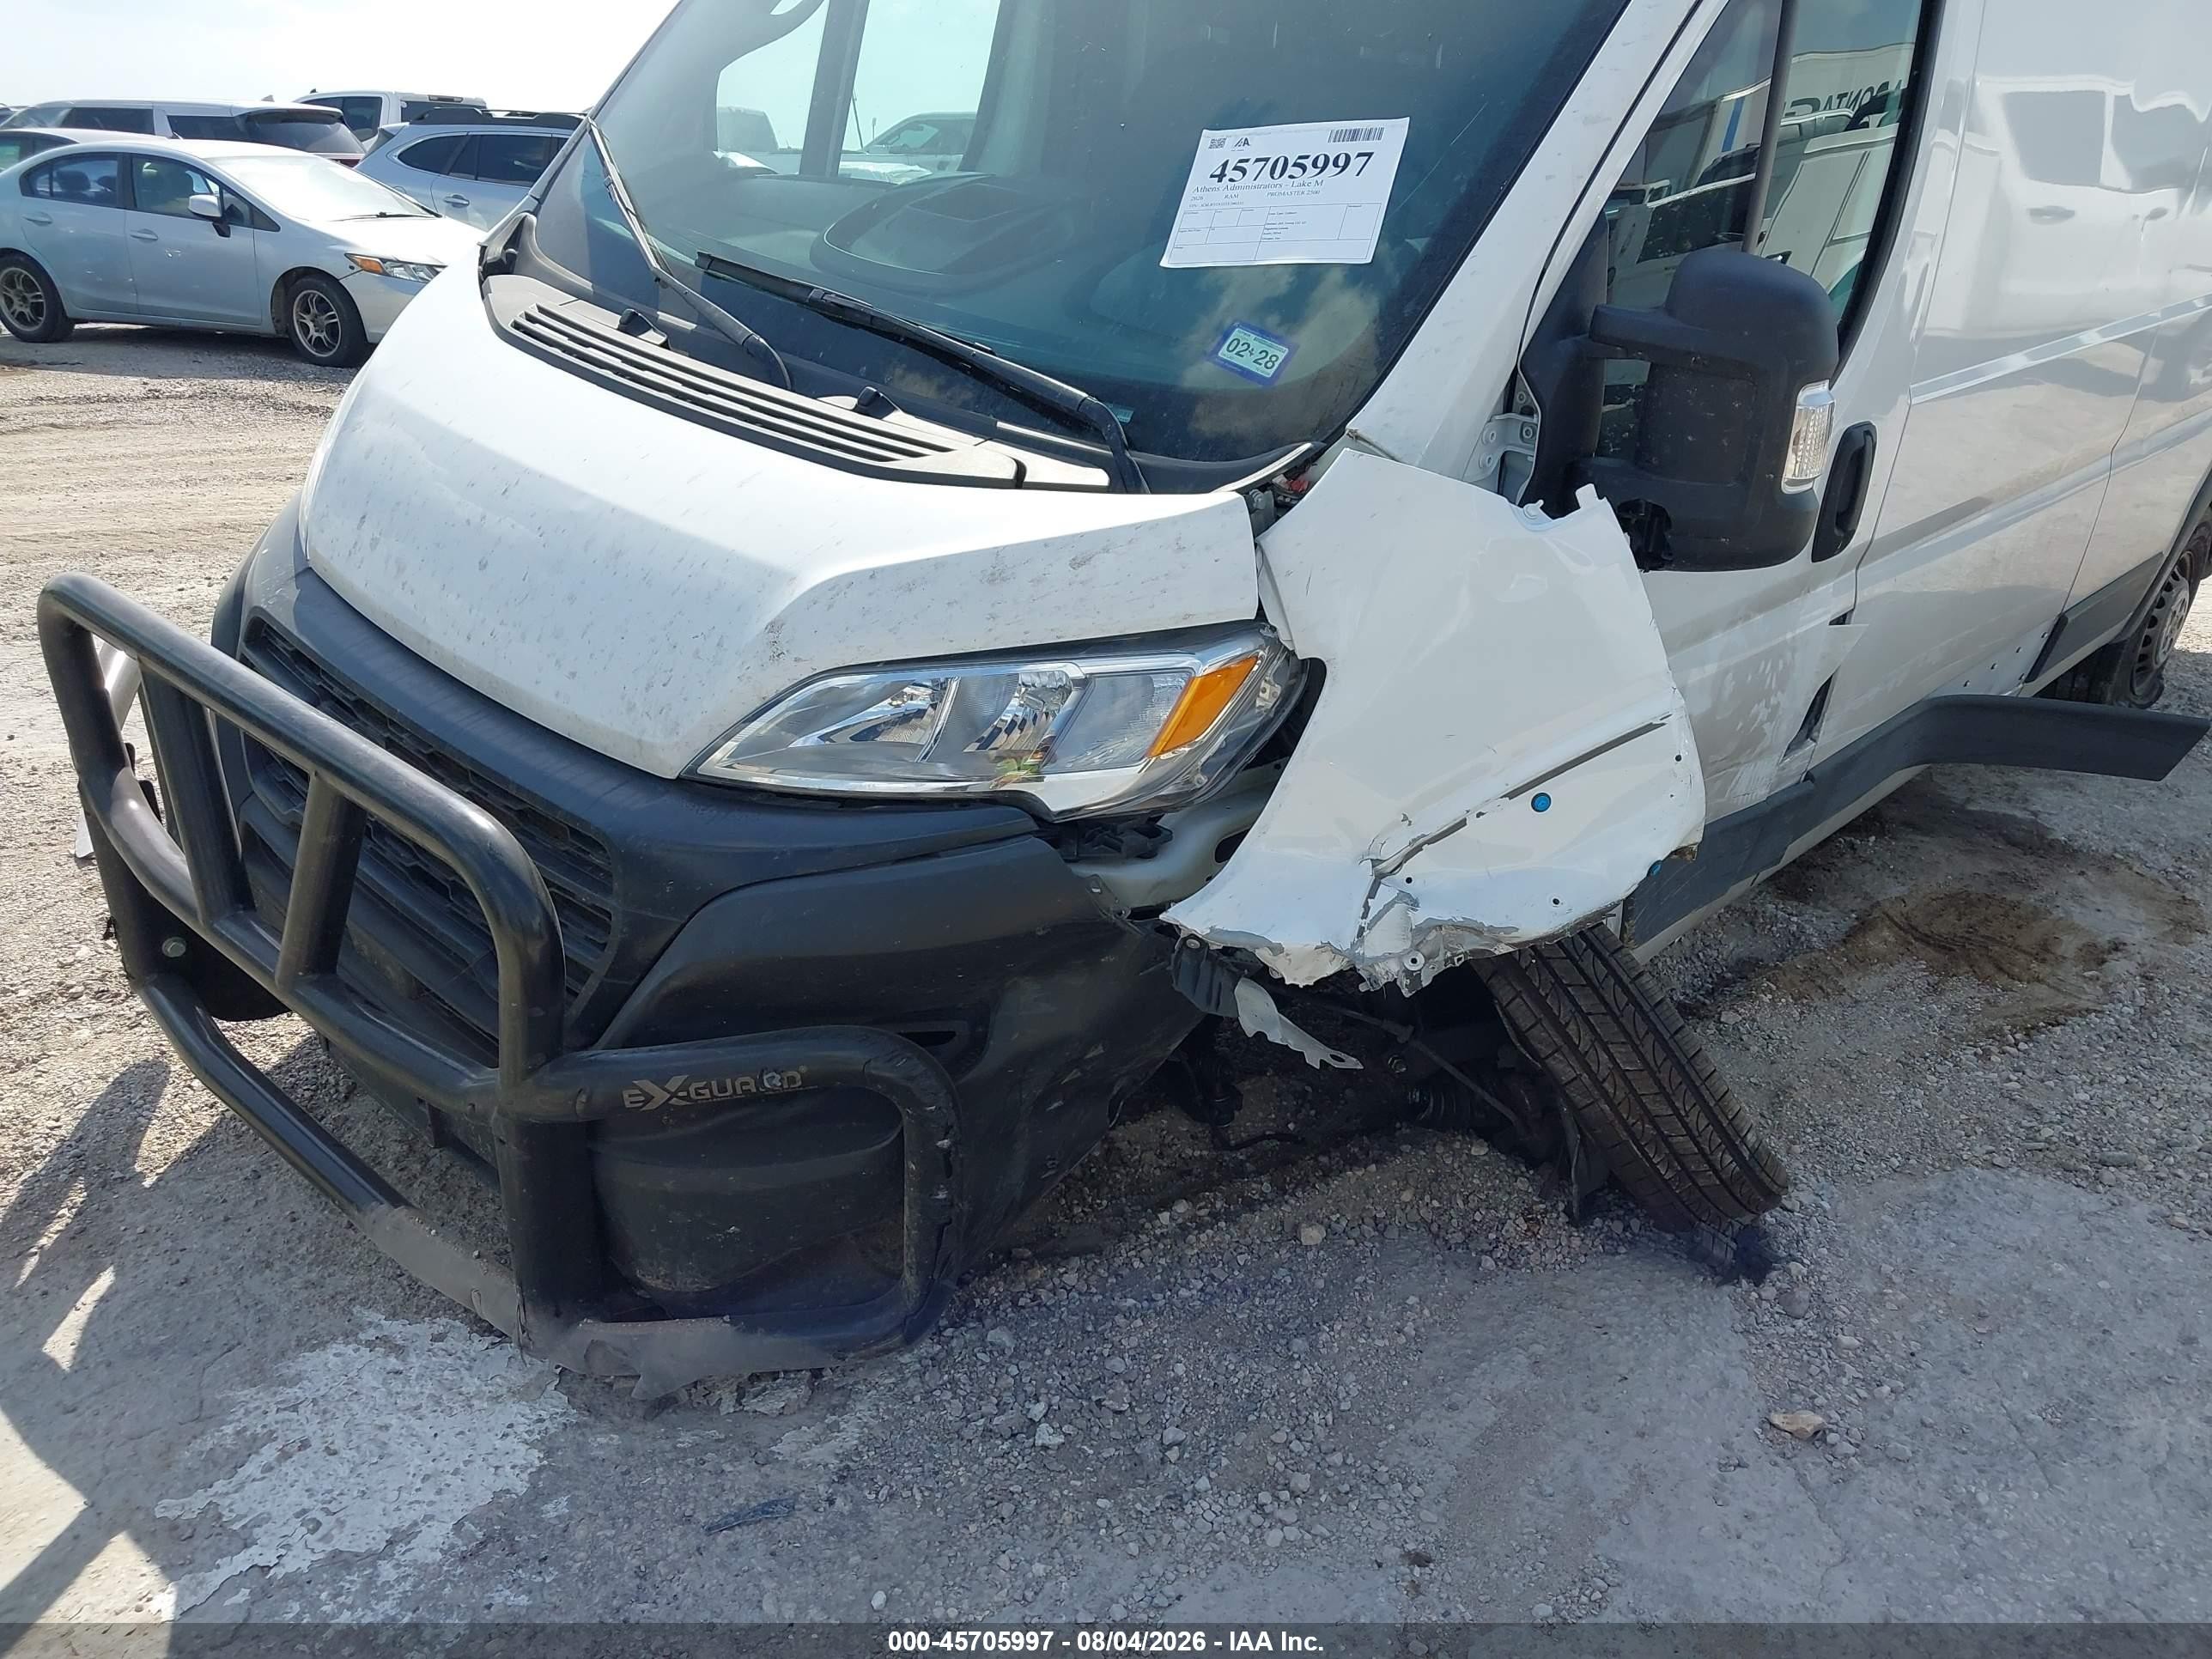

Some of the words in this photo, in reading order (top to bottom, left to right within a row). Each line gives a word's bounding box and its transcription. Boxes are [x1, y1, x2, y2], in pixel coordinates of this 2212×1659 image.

[1209, 151, 1375, 183] 45705997
[1193, 185, 1220, 193] Athens
[1222, 182, 1284, 191] Administrators
[1291, 179, 1312, 188] Lake
[1226, 337, 1251, 358] 02
[1253, 349, 1279, 370] 28
